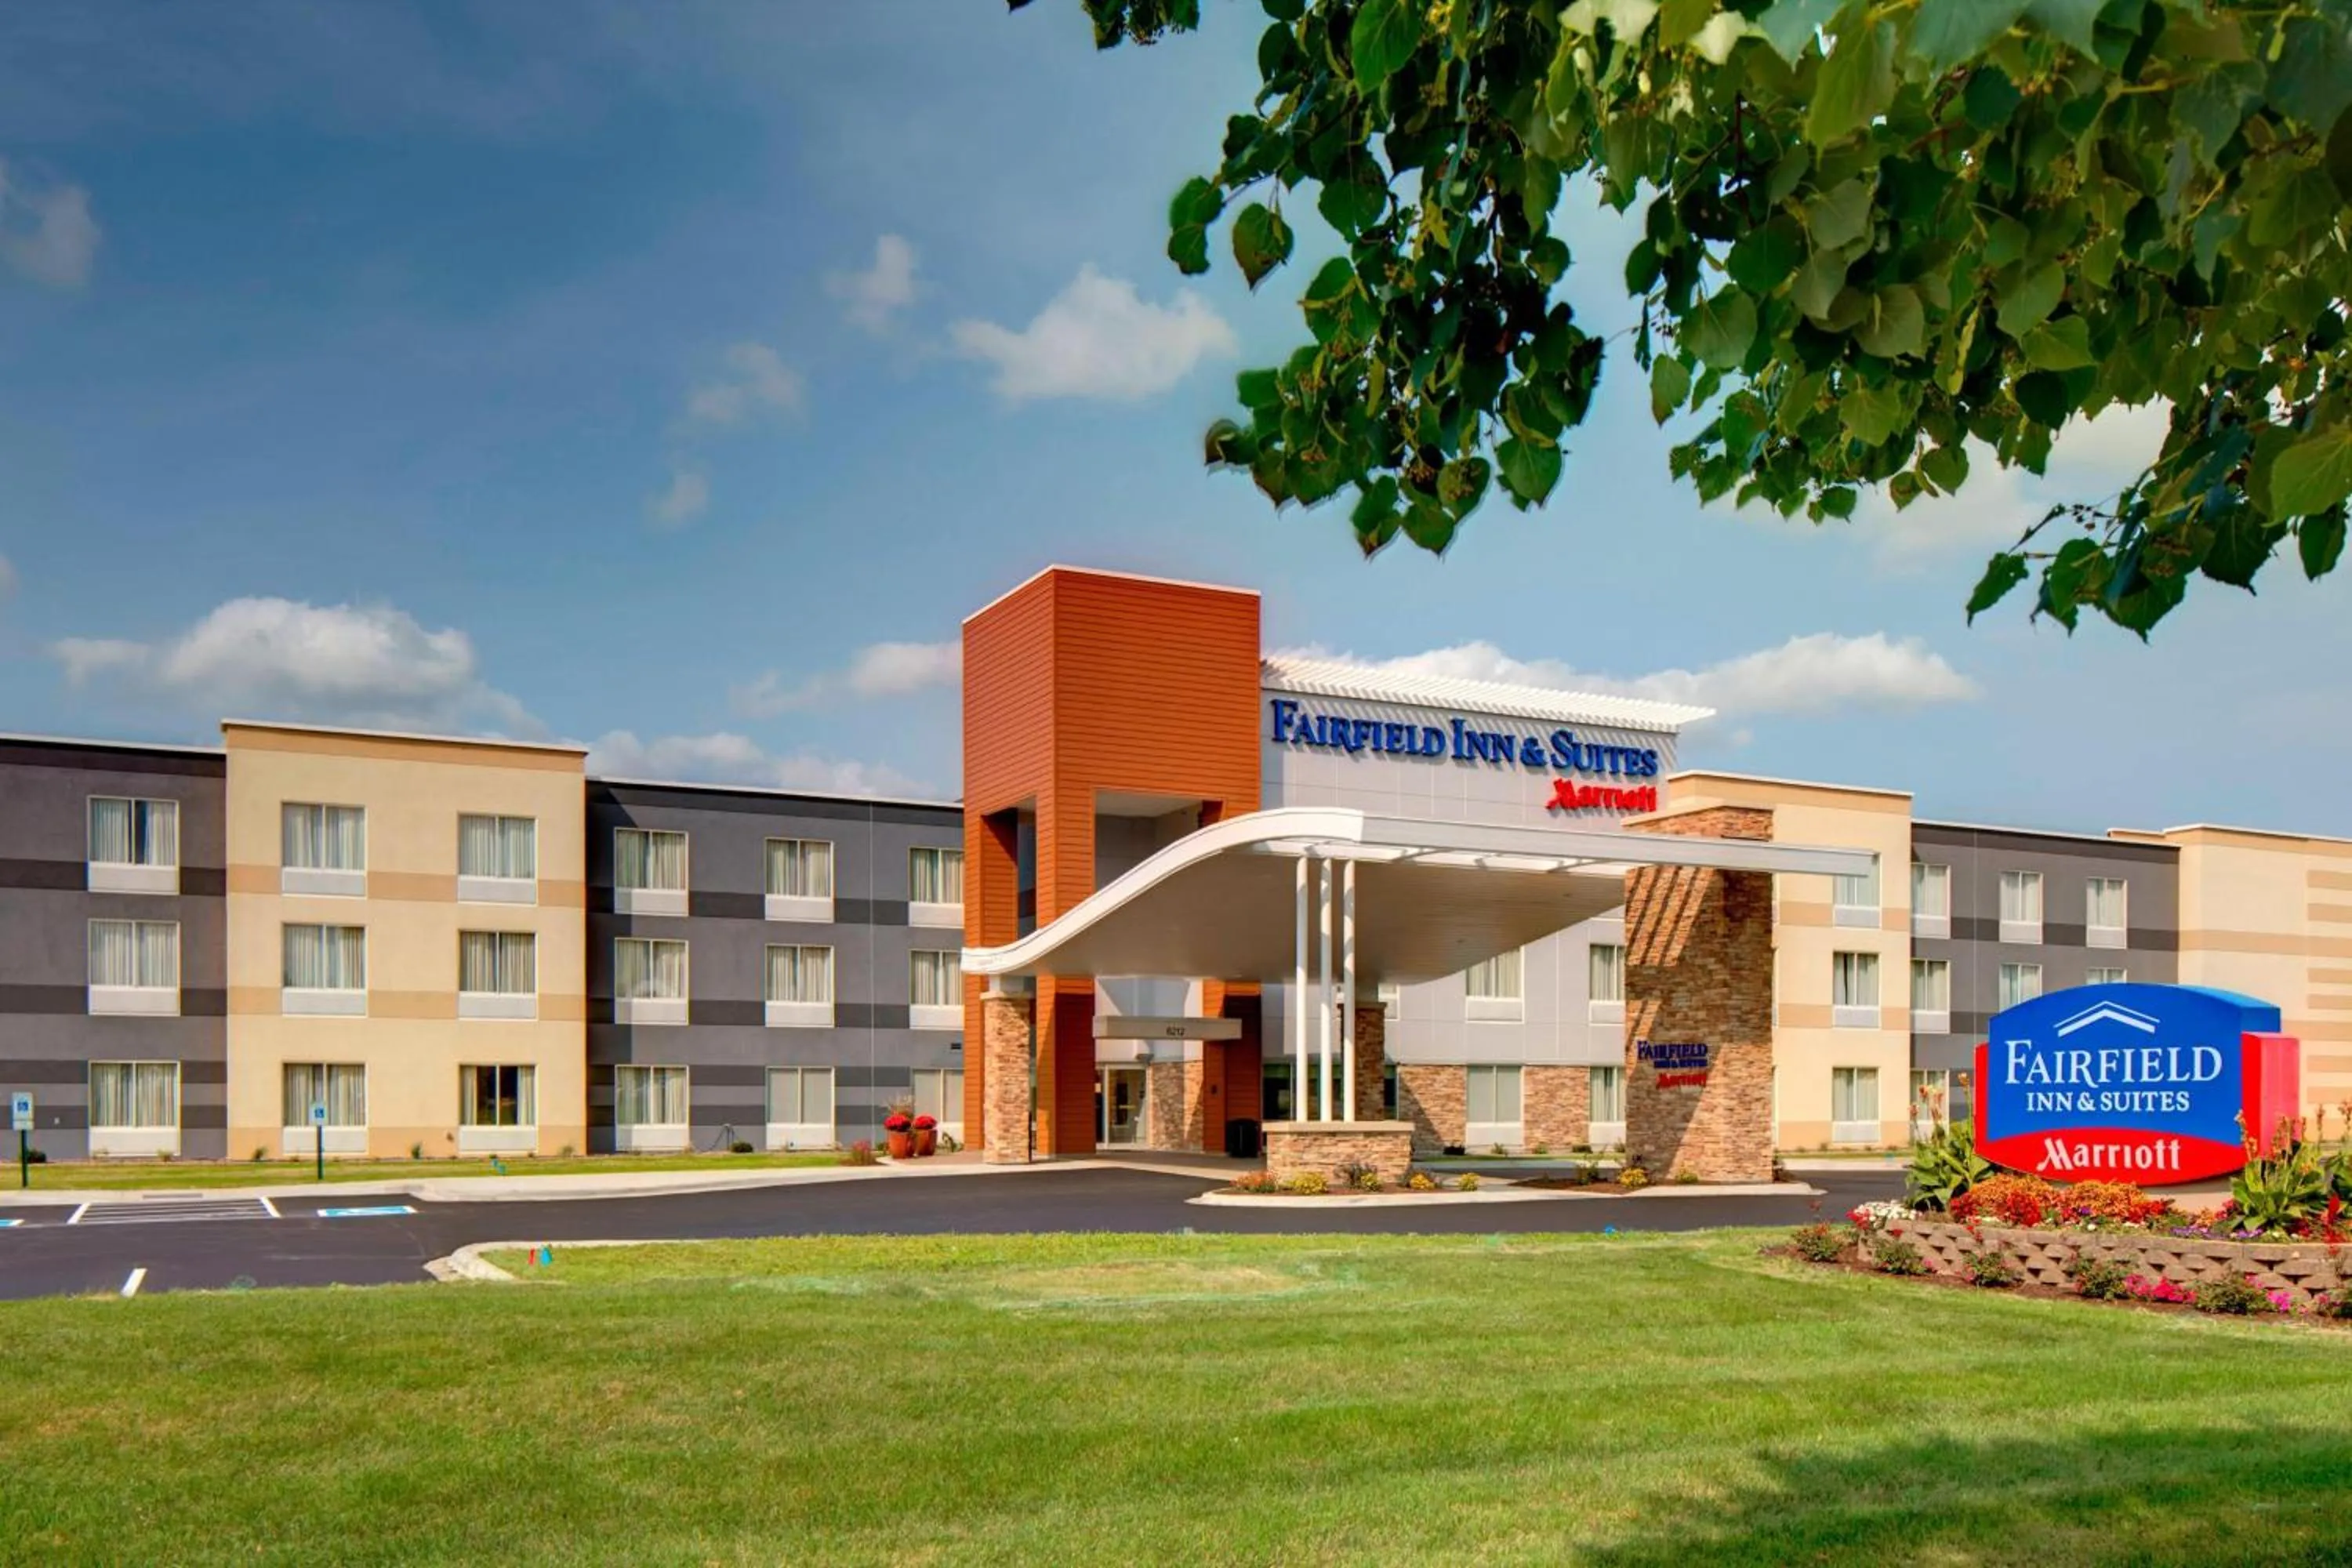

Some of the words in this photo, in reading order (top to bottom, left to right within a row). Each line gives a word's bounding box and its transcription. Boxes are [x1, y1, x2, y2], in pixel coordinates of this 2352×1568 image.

[1271, 699, 1446, 757] FAIRFIELD
[1451, 718, 1515, 763] INN
[1519, 736, 1547, 767] &
[1551, 729, 1658, 776] SUITES
[1546, 778, 1657, 812] Marriott
[2005, 1040, 2223, 1087] FAIRFIELD
[2027, 1091, 2073, 1112] INN
[2078, 1092, 2096, 1112] &
[2100, 1091, 2190, 1112] SUITES
[2036, 1138, 2181, 1171] Marriott
